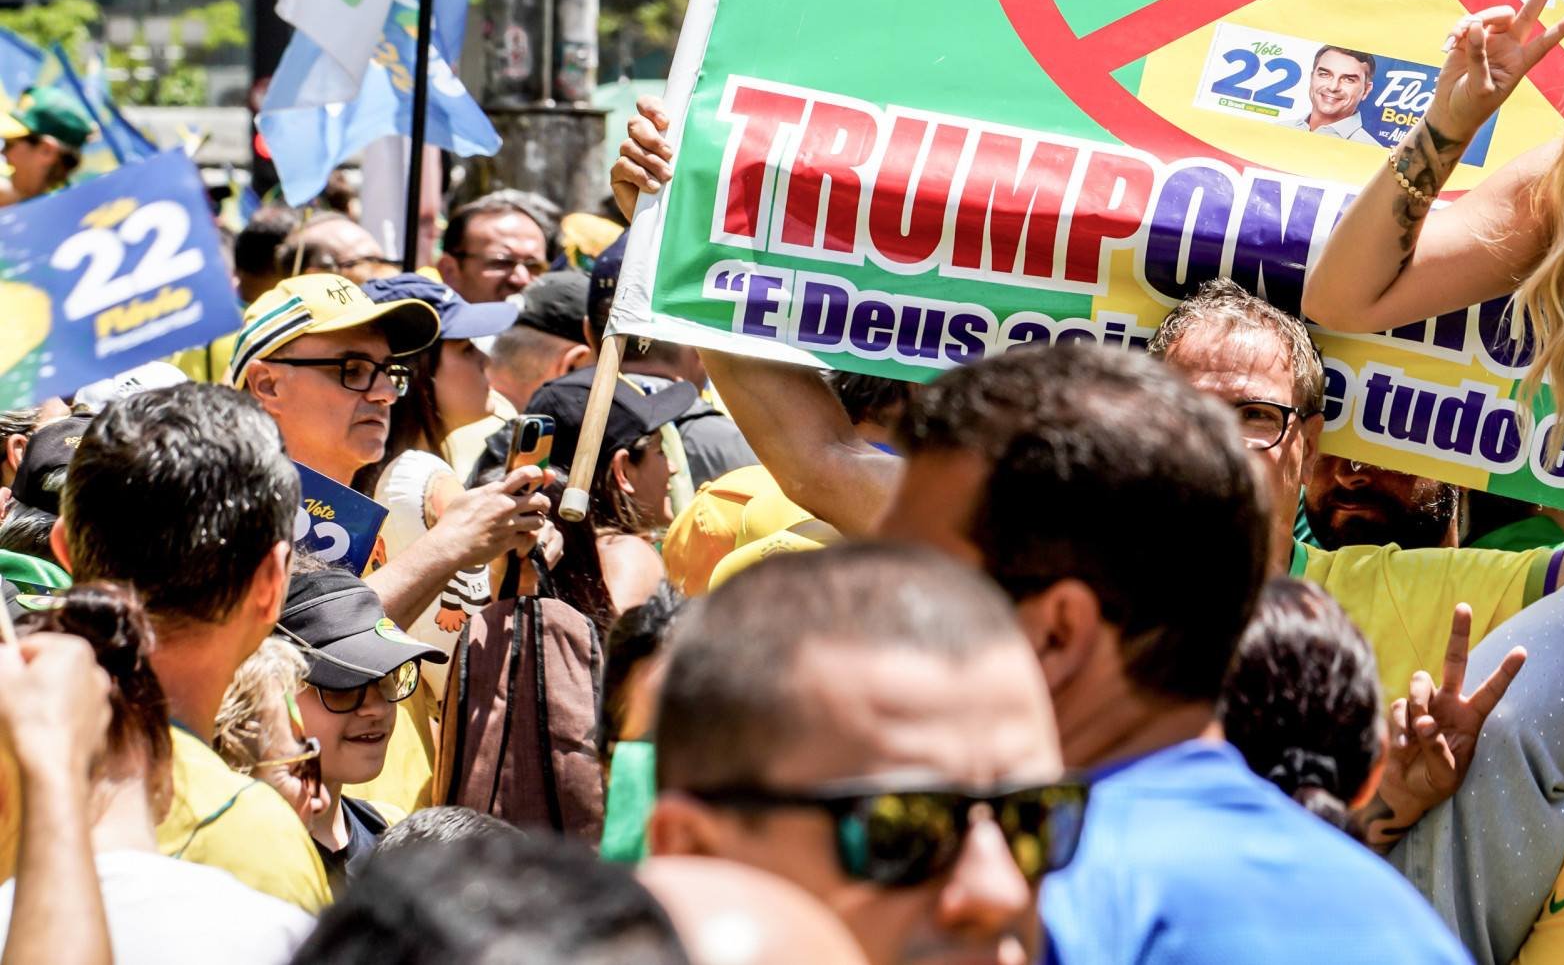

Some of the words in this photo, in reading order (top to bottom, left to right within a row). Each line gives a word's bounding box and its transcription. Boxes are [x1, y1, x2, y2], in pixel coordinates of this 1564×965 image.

[1210, 48, 1303, 110] 22
[1251, 40, 1284, 57] Vote
[50, 199, 206, 322] 22
[797, 281, 990, 367] Deus
[1364, 371, 1523, 464] tudo
[304, 498, 336, 521] Vote
